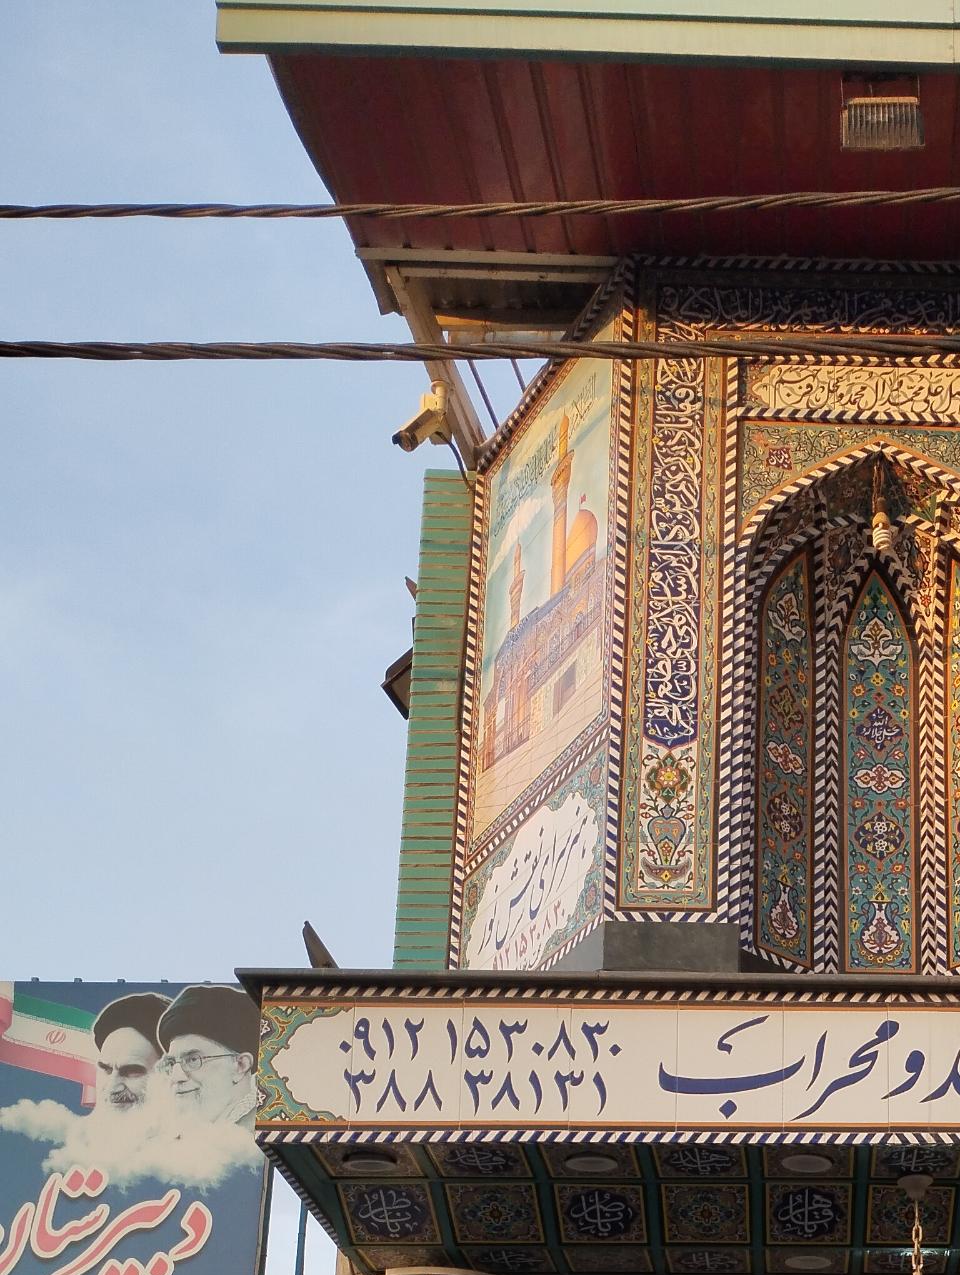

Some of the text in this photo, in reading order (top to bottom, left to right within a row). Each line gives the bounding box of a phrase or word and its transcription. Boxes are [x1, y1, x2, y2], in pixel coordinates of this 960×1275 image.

[477, 884, 499, 956] نور
[339, 1014, 623, 1064] ۰۹۱۲ ۱۵۳۰۸۳۰
[344, 1067, 608, 1116] ۳۸۸ ۳۸۱۳۱
[659, 1015, 901, 1121] محراب
[881, 1049, 925, 1100] و
